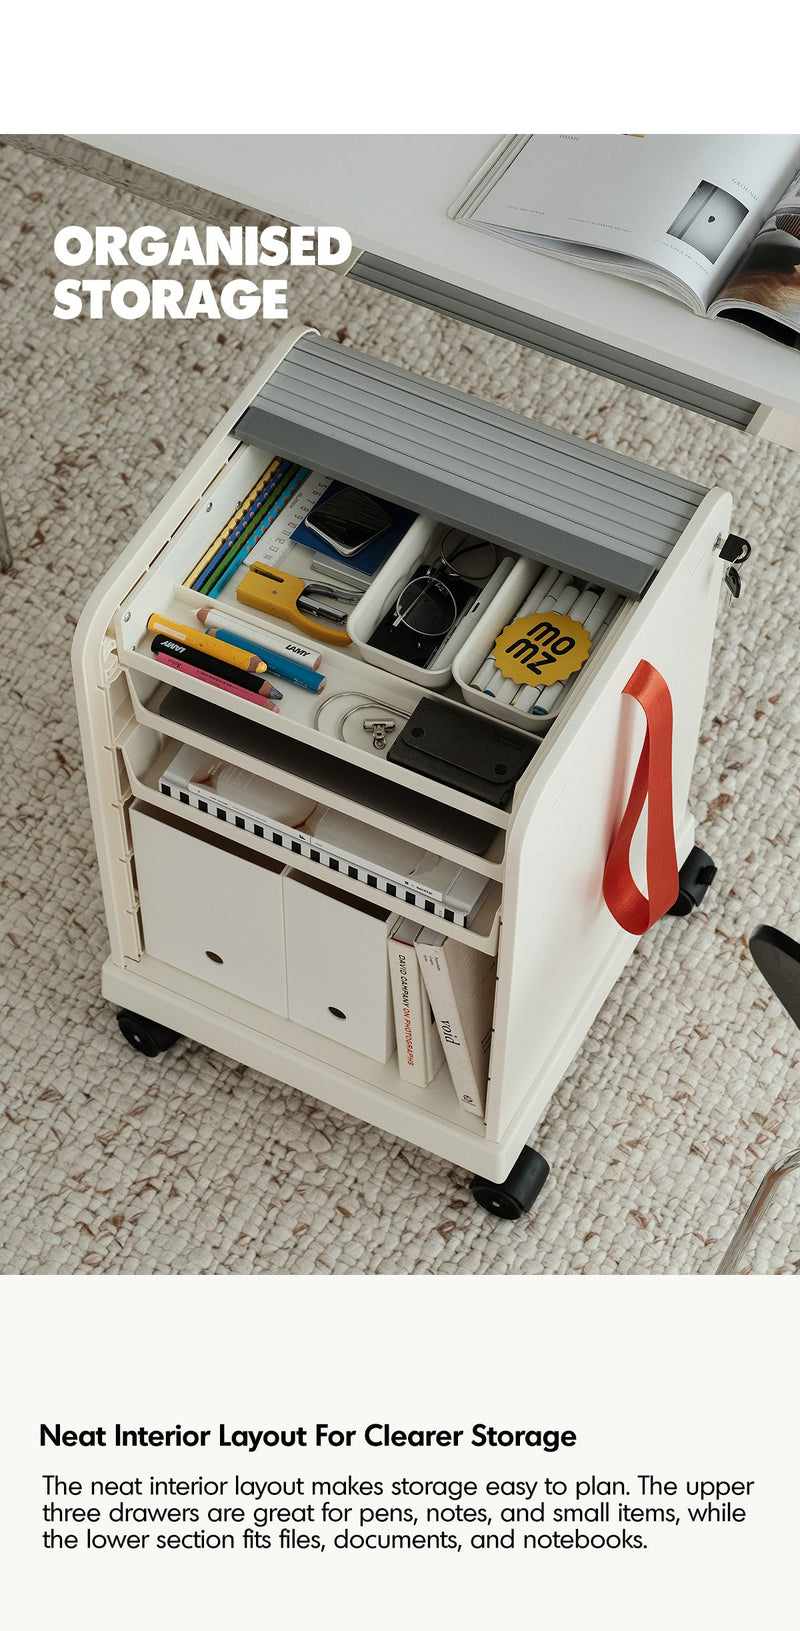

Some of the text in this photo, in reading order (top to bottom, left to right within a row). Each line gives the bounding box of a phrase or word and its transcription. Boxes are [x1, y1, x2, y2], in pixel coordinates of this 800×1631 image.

[731, 178, 758, 201] GROUND
[160, 641, 186, 653] LAMY
[285, 644, 311, 658] LAMY
[526, 621, 576, 656] mo
[398, 954, 415, 1067] DAVID CAMPANY ON PHOTOGRAPHS
[440, 1019, 461, 1048] void
